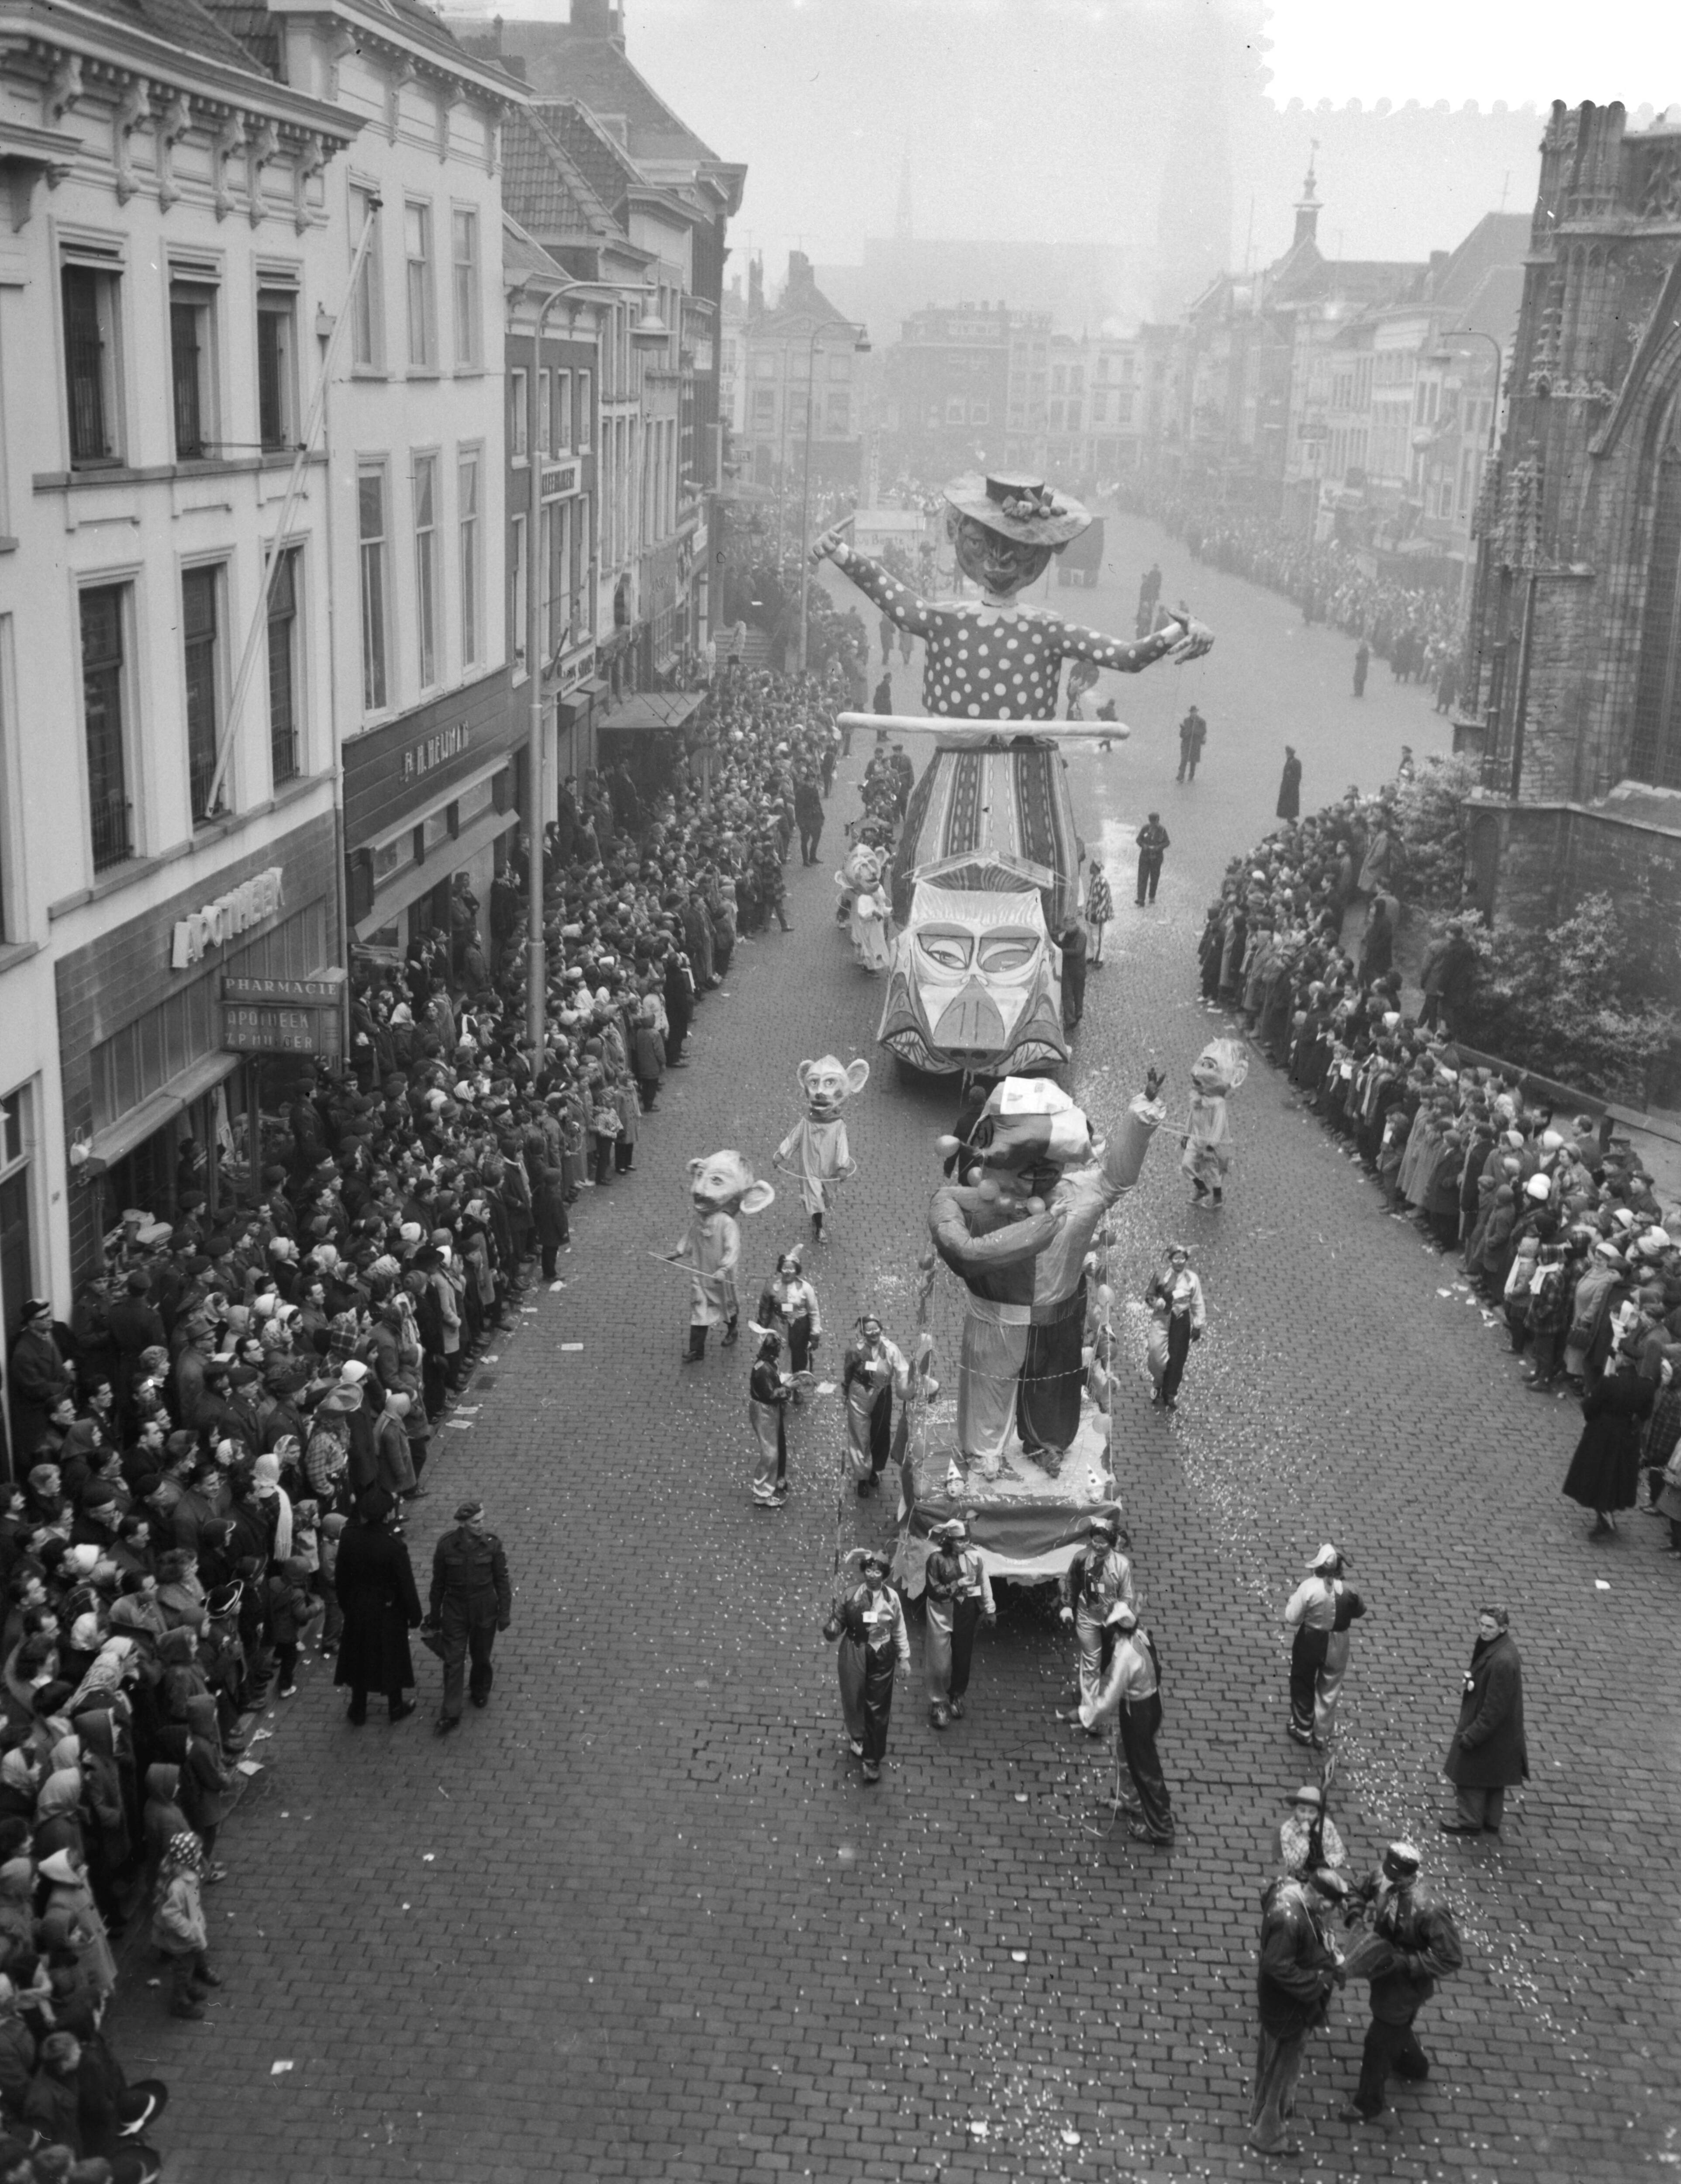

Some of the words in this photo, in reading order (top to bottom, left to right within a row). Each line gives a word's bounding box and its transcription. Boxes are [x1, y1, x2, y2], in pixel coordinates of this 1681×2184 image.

[172, 867, 285, 968] APOTHEEK
[225, 978, 336, 995] PHARMACIE
[227, 1010, 309, 1029] APOTHEEK
[252, 1034, 313, 1049] MUDER
